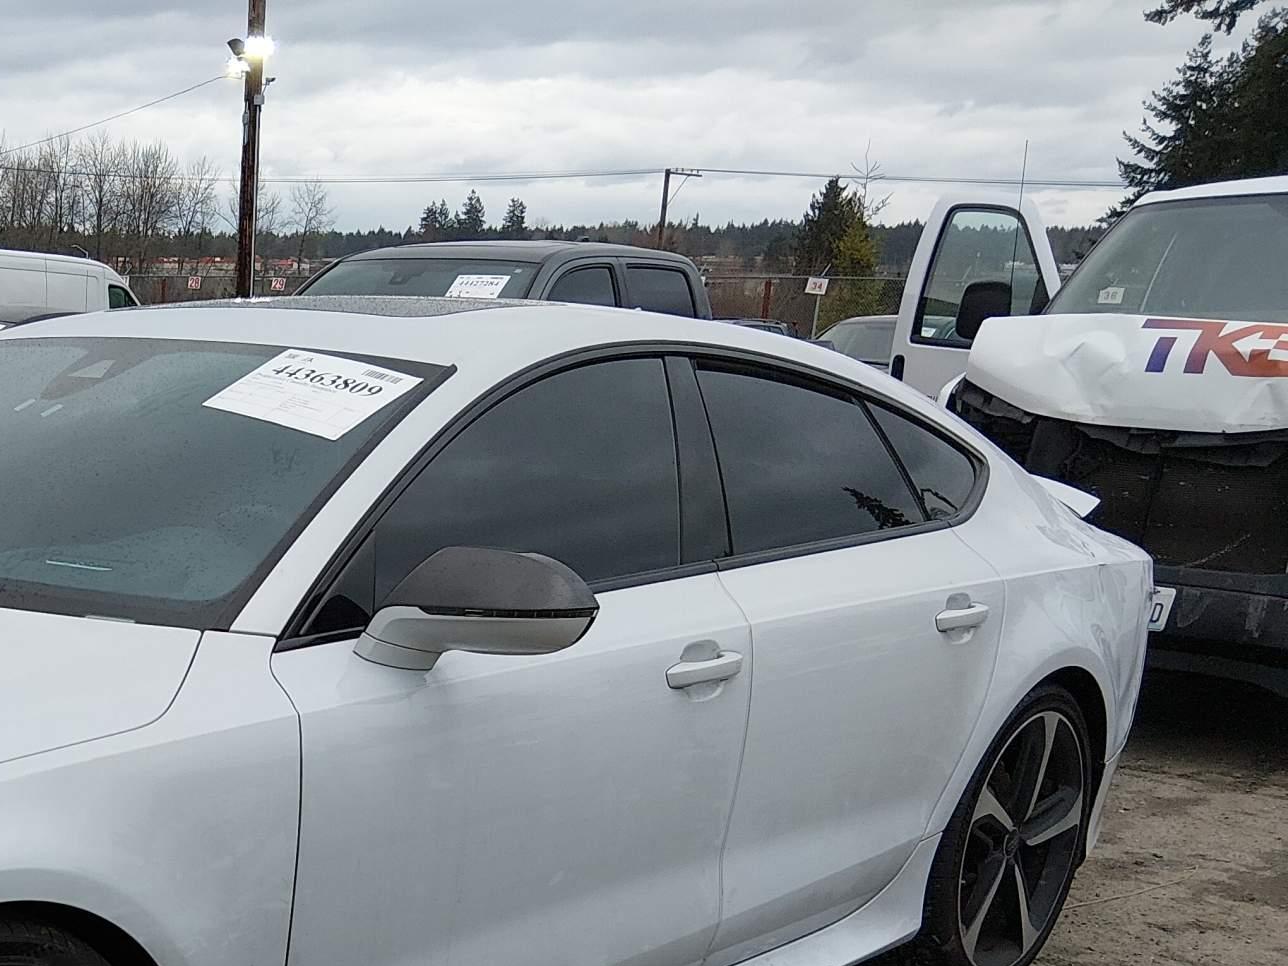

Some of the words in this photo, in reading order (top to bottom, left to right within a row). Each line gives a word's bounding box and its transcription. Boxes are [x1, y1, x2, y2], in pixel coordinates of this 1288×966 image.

[189, 277, 200, 288] 28
[273, 279, 285, 289] 29
[272, 364, 383, 396] 44363809
